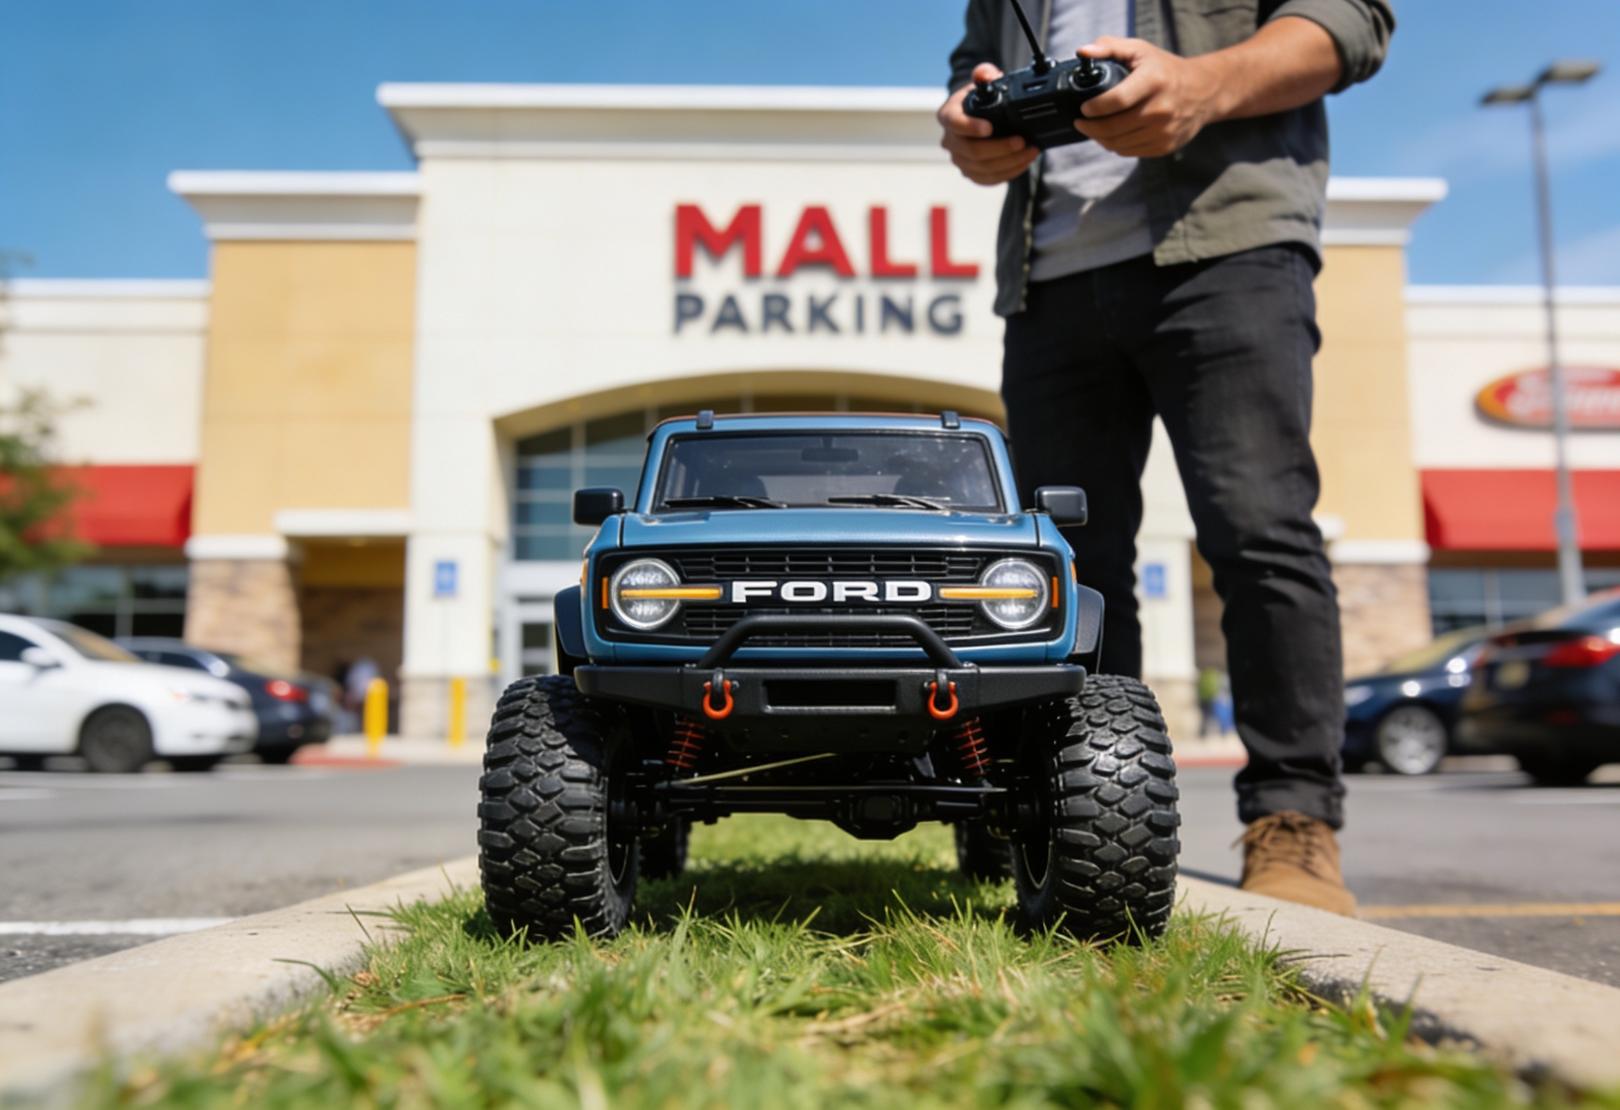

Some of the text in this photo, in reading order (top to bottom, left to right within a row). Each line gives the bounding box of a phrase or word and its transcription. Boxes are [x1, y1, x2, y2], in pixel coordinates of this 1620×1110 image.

[674, 203, 979, 279] MALL
[674, 293, 964, 336] PARKING
[731, 580, 932, 603] FORD
